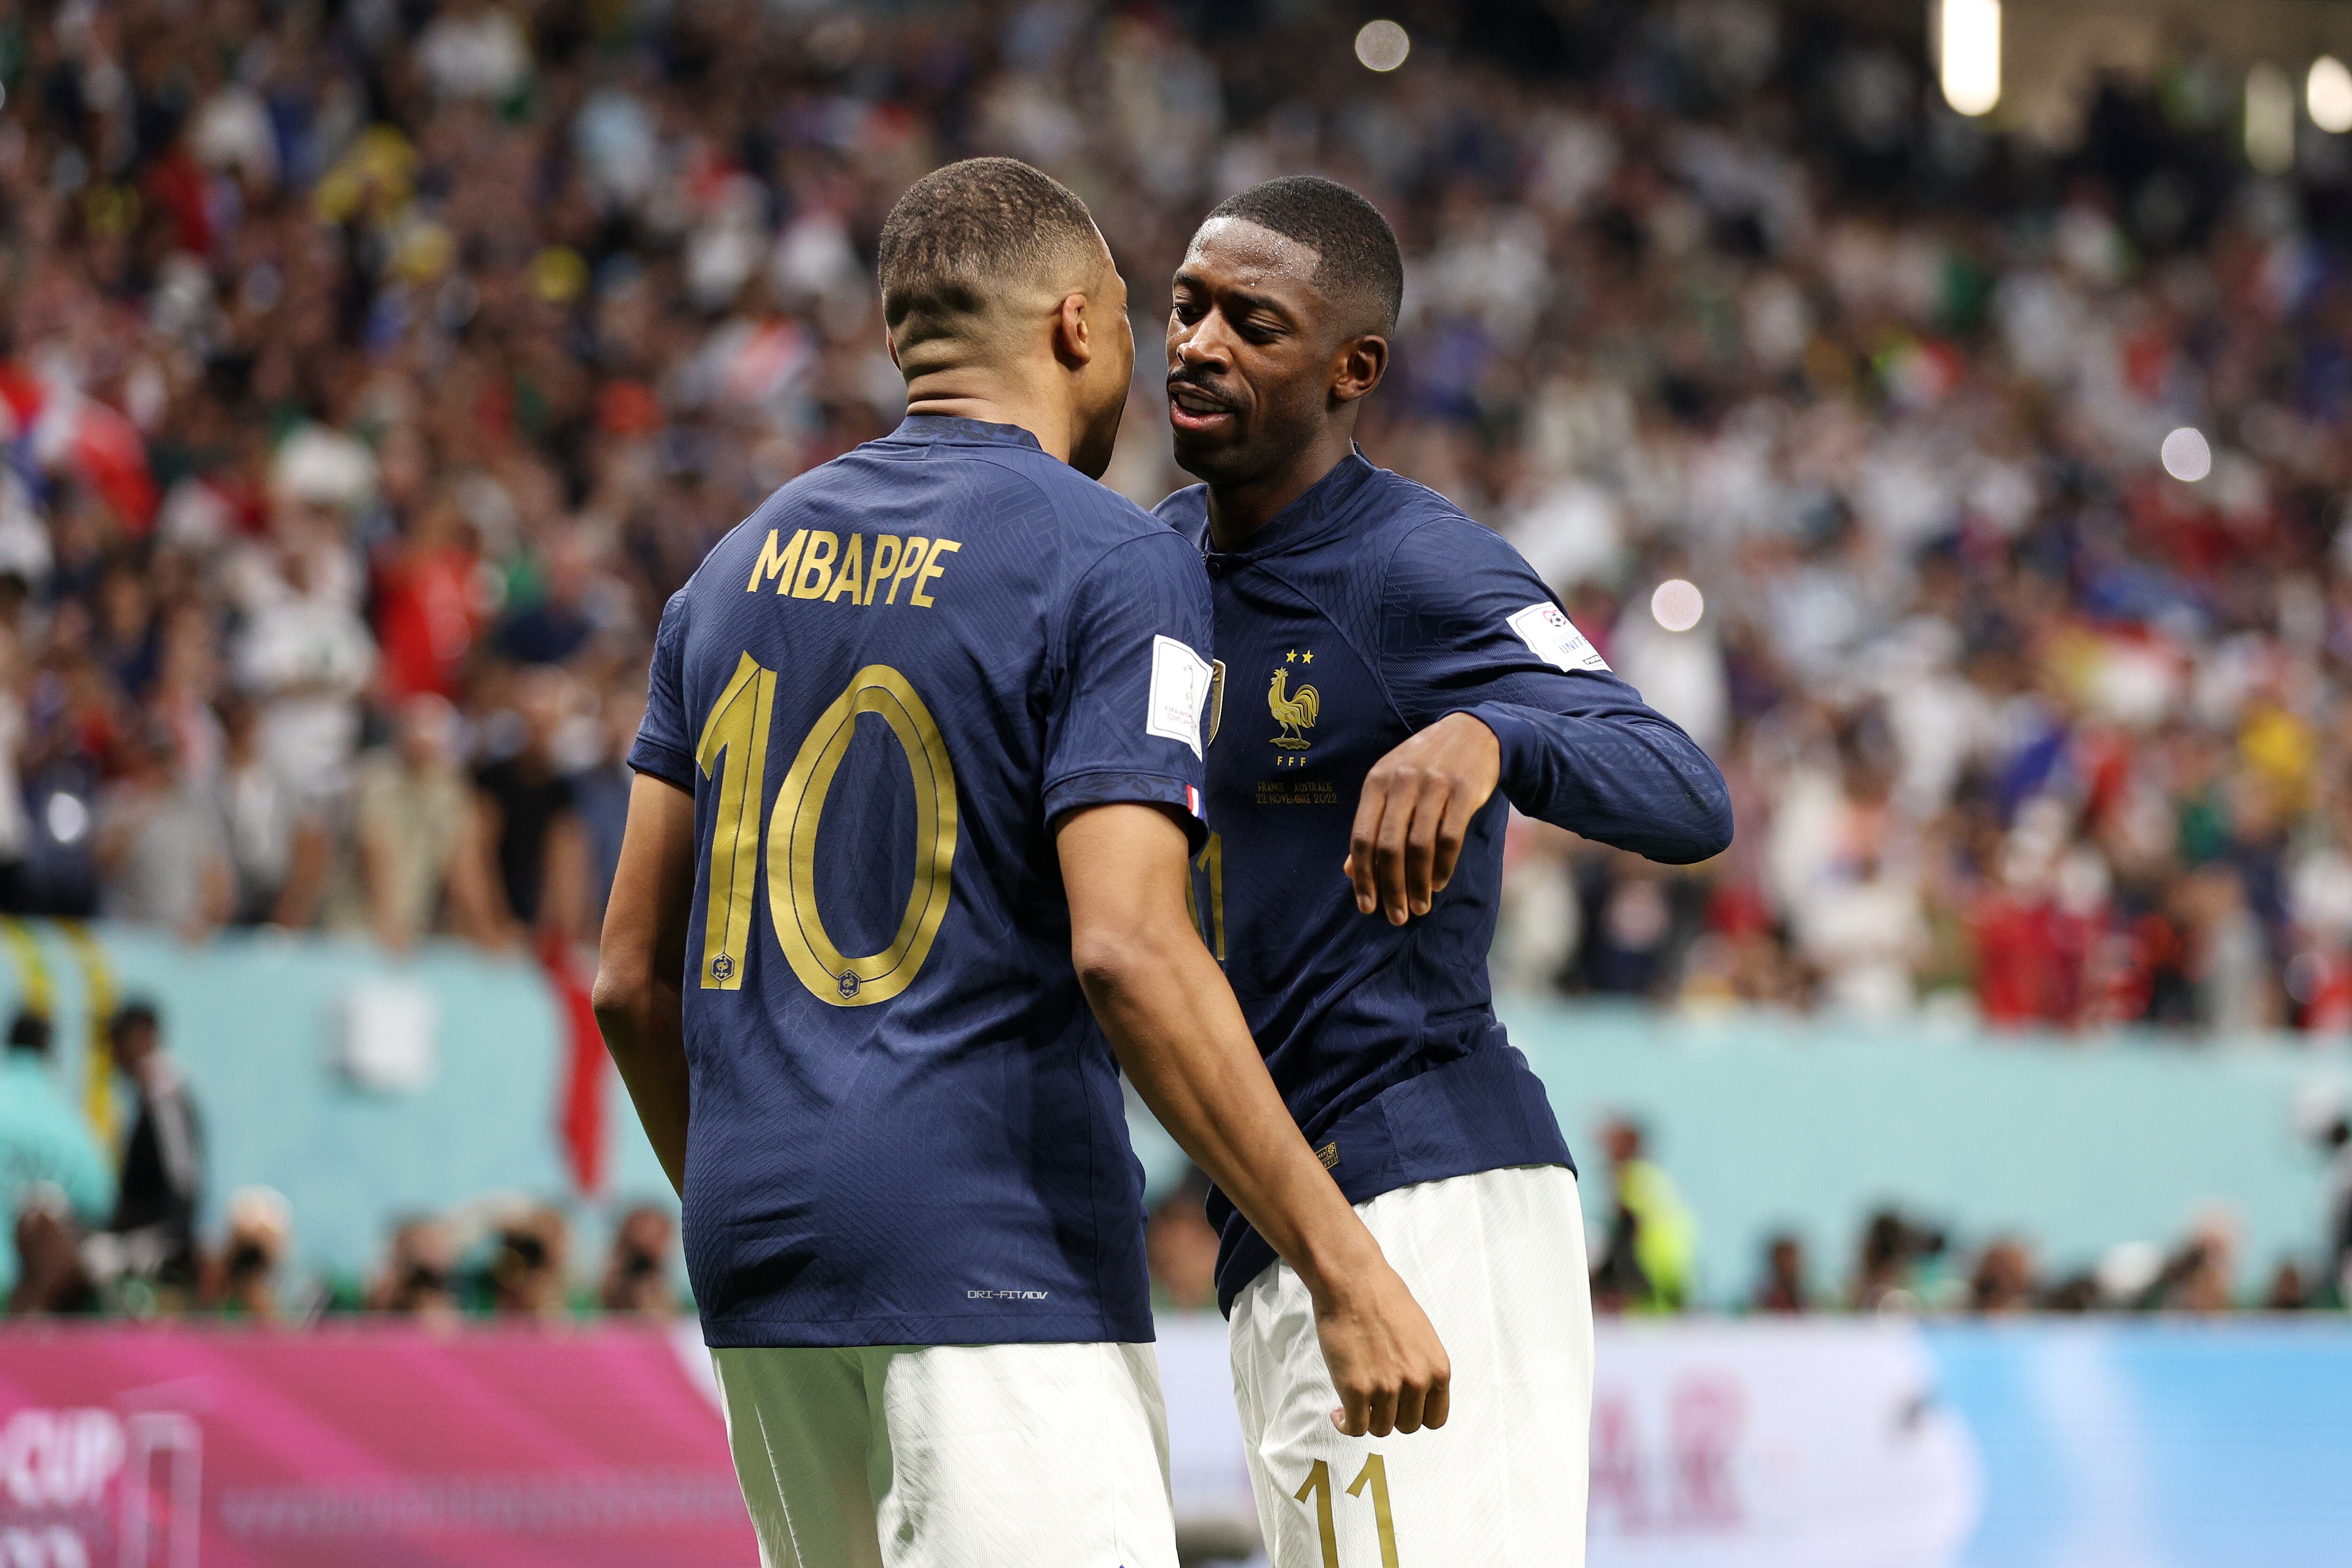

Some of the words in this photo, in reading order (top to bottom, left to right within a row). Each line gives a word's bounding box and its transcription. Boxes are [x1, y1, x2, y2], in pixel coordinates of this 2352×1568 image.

[747, 528, 962, 608] MBAPPE
[1277, 756, 1306, 767] FFF
[1256, 793, 1268, 804] 22
[1269, 793, 1311, 804] NOVEMBRE
[1313, 793, 1339, 804] 2022
[1257, 782, 1285, 792] FRANCE
[1294, 782, 1333, 792] AUSTRALIE
[696, 650, 958, 1007] 10
[1294, 1452, 1399, 1568] 11
